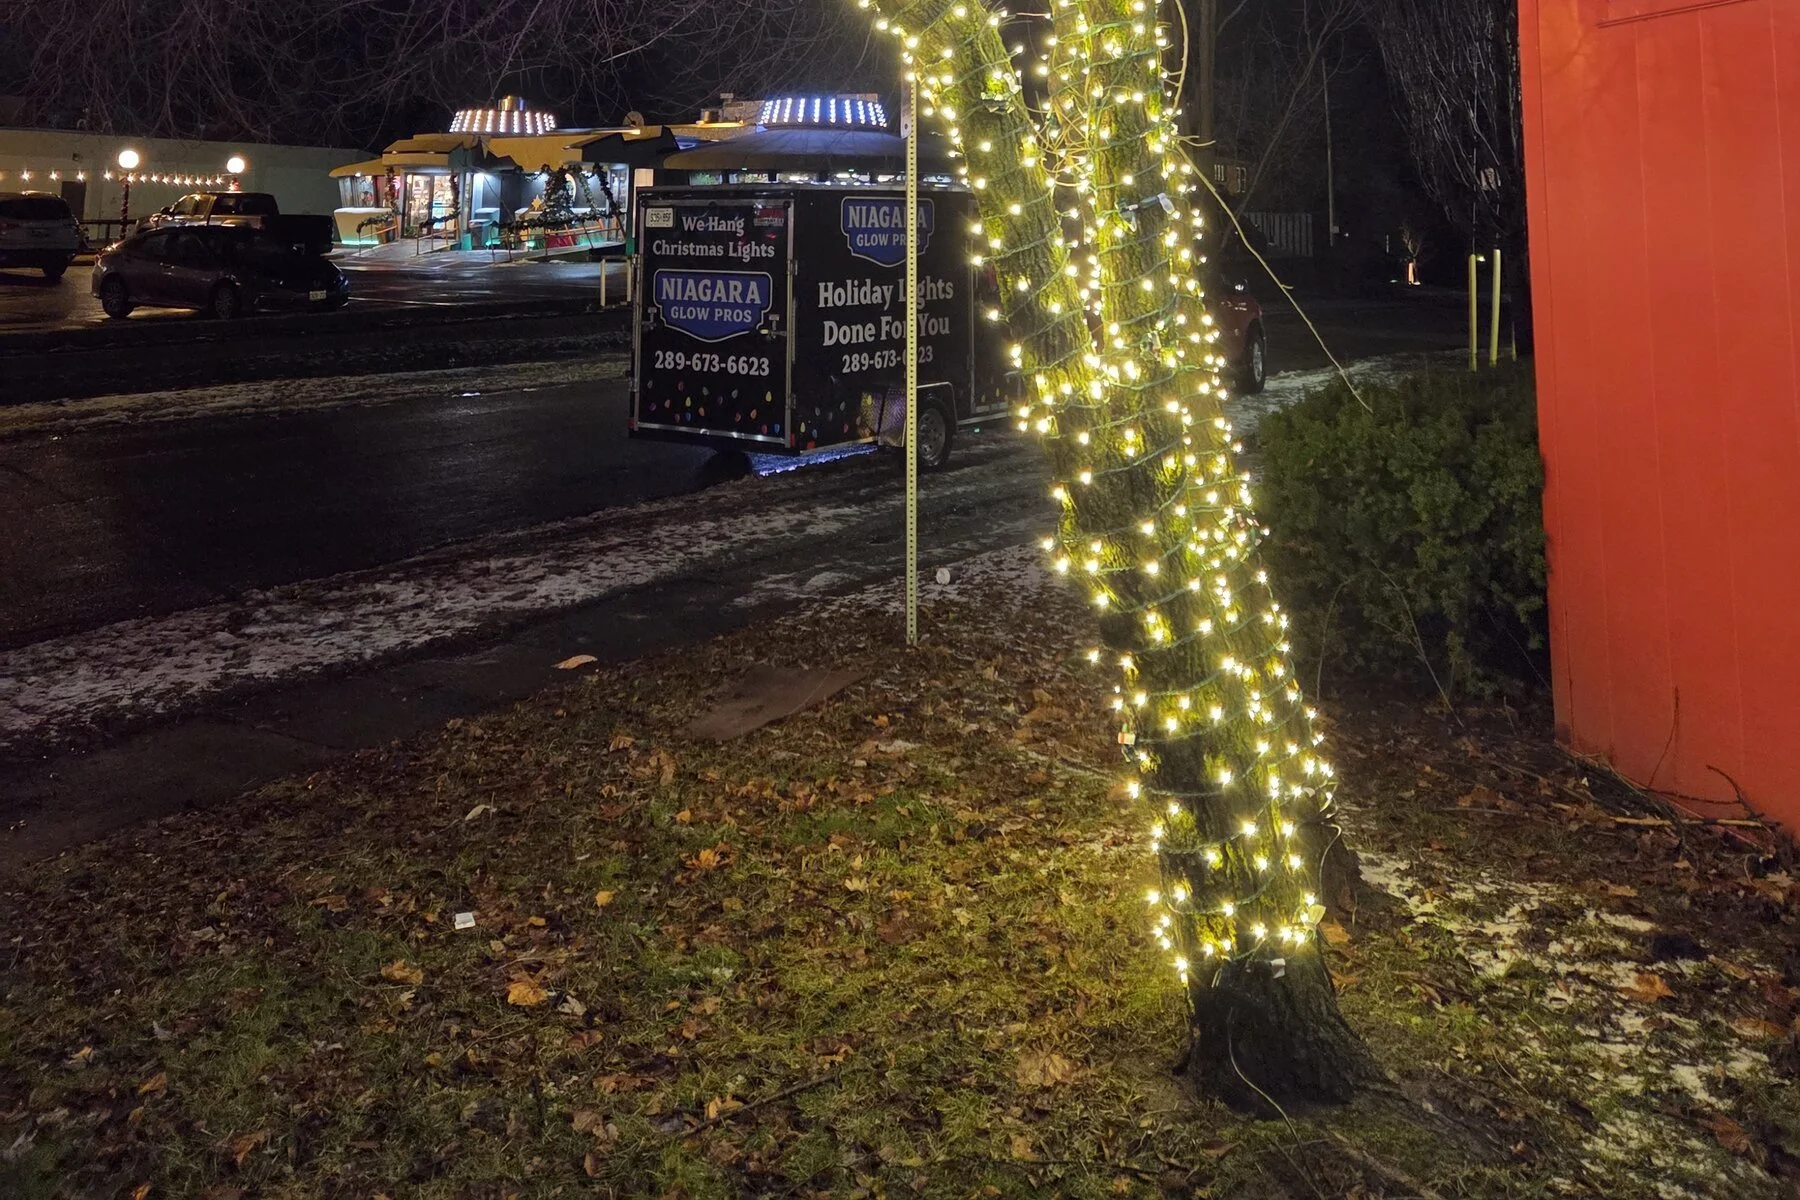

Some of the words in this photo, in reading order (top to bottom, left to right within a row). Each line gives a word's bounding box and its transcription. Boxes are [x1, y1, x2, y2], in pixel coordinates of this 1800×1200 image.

[682, 216, 705, 232] We
[707, 216, 745, 237] Hang
[856, 233, 889, 247] GLOW
[892, 233, 921, 247] PRS
[652, 239, 724, 257] Christmas
[728, 241, 775, 263] Lights
[661, 277, 762, 305] NIAGARA
[817, 278, 894, 311] Holiday
[898, 275, 954, 310] Lghts
[671, 305, 710, 321] GLOW
[714, 307, 752, 323] PROS
[823, 320, 876, 347] Done
[917, 312, 950, 337] You
[654, 350, 770, 377] 289-673-6623
[842, 345, 934, 374] 289-673-23
